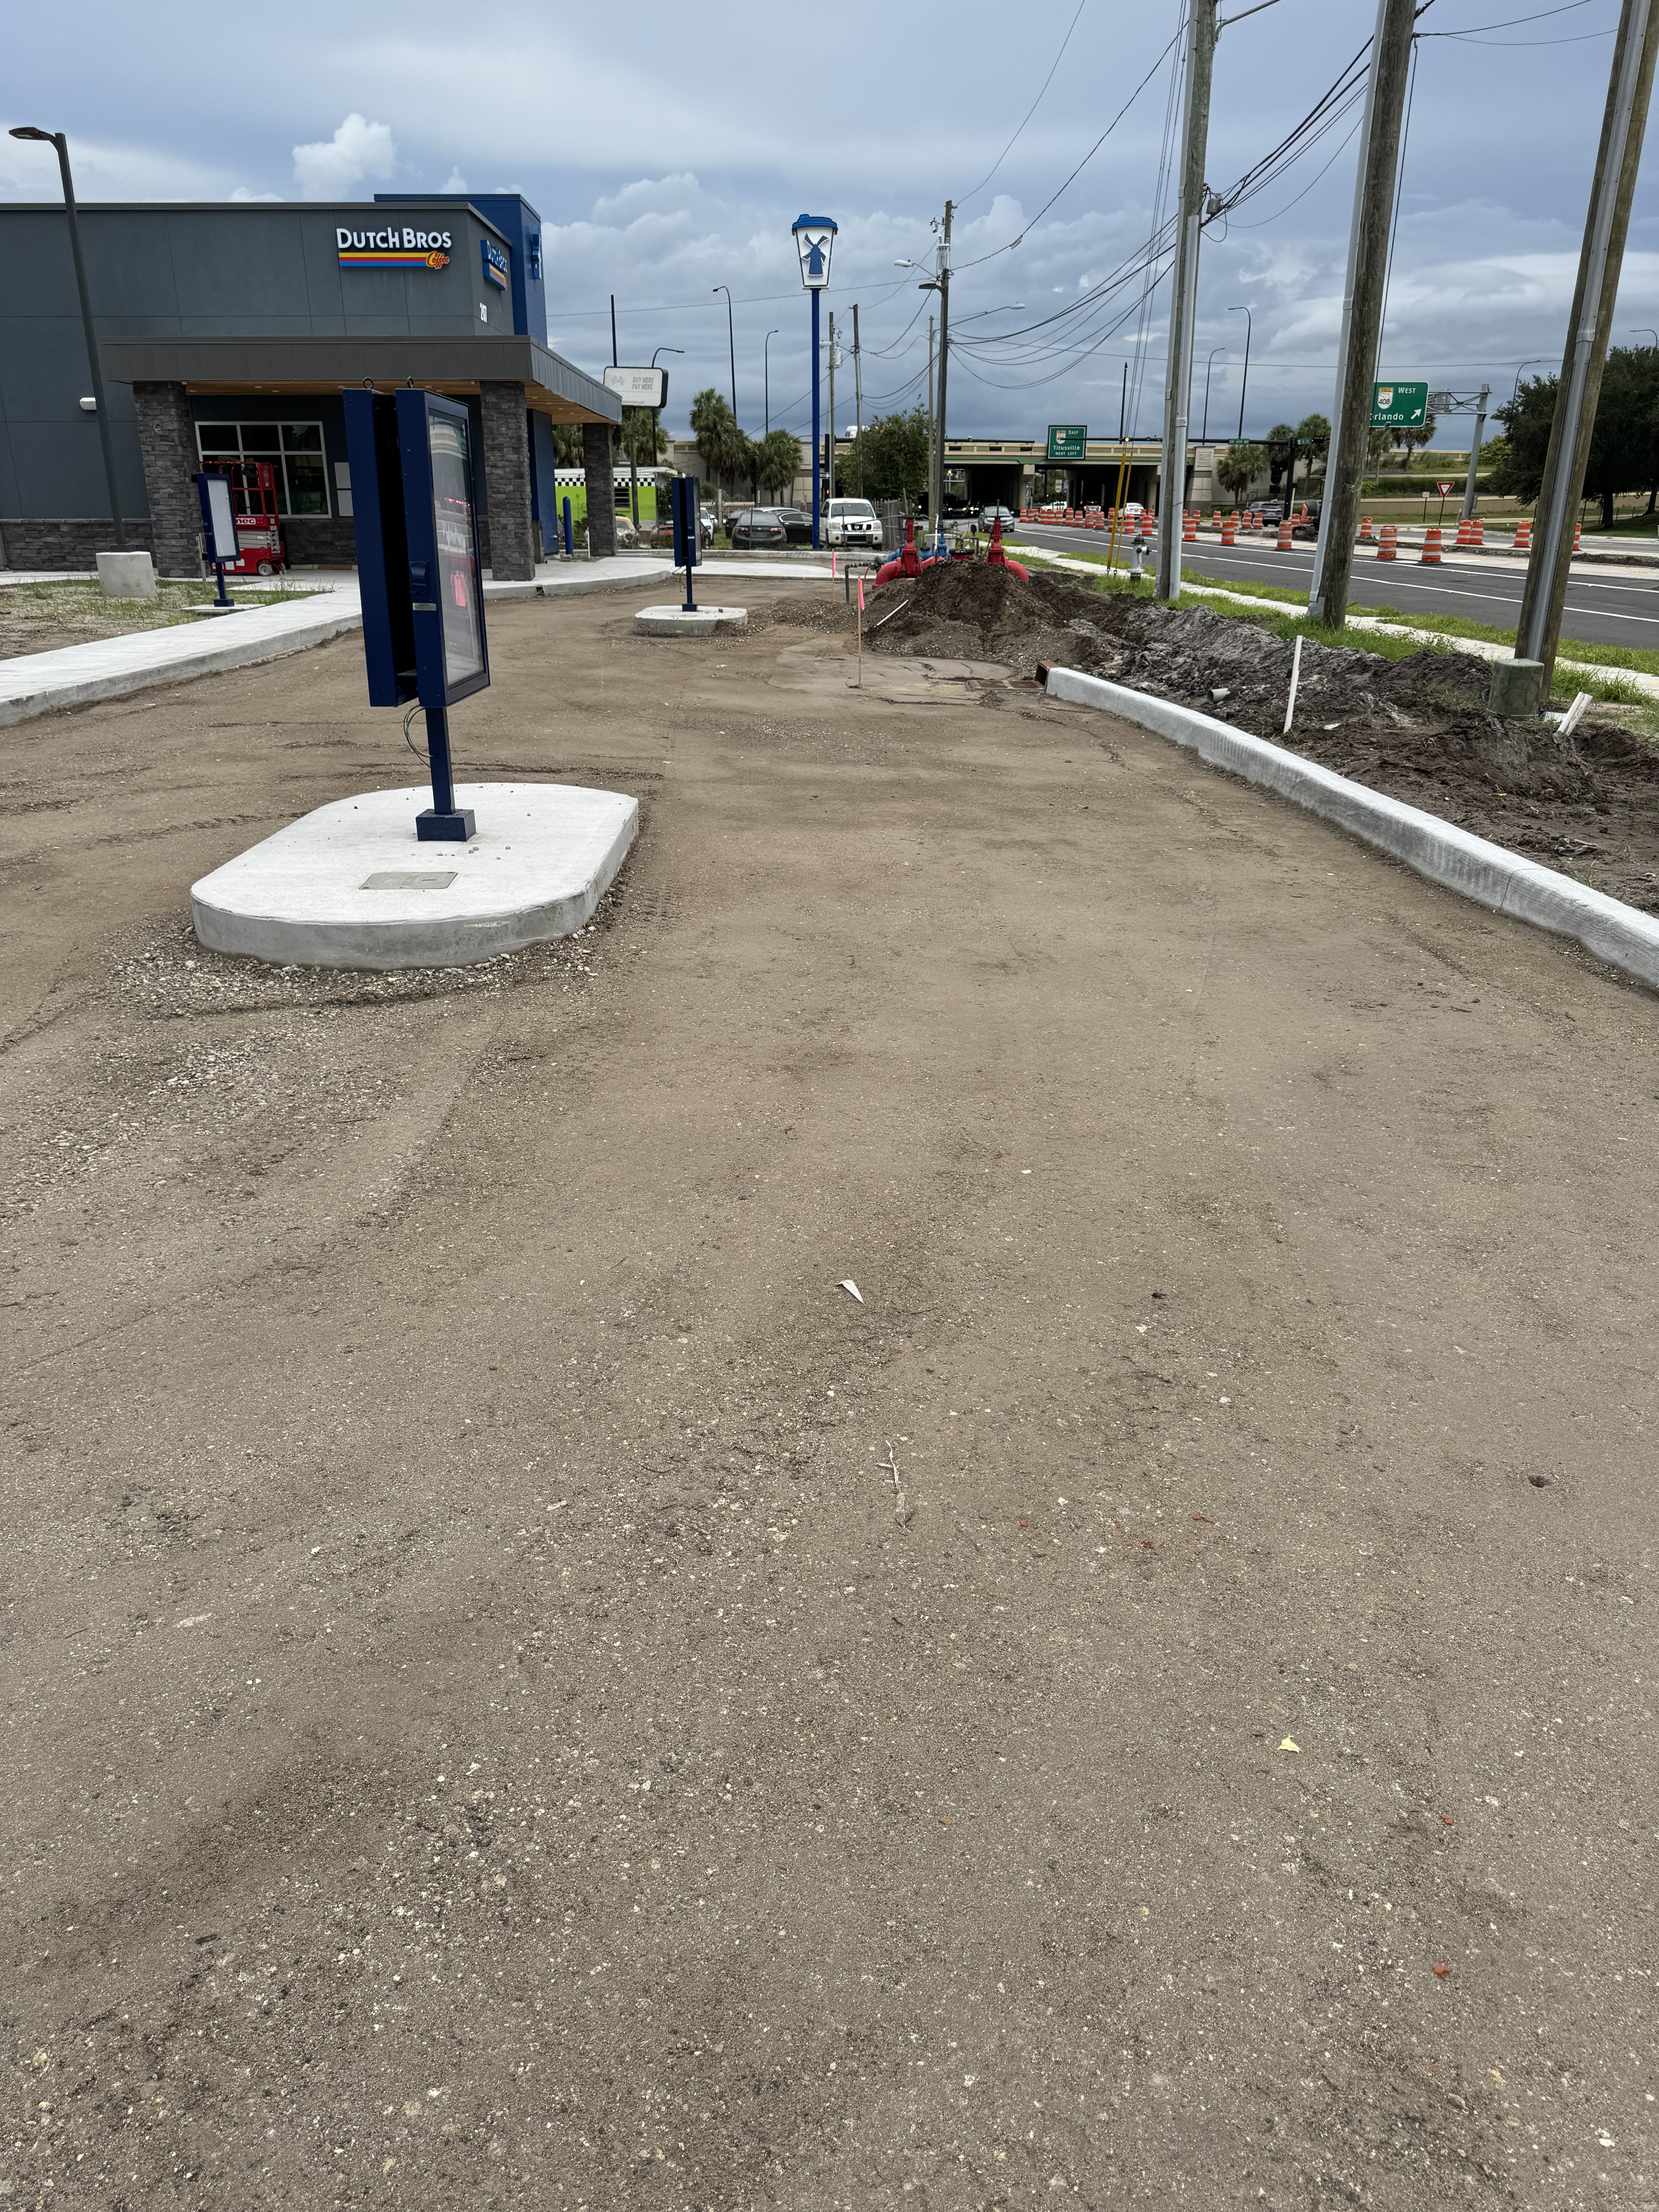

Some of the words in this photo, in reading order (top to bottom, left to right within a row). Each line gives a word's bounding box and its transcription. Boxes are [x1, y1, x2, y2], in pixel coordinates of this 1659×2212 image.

[336, 227, 400, 248] DUTCH
[402, 228, 452, 248] BROS
[426, 251, 449, 269] Coffee
